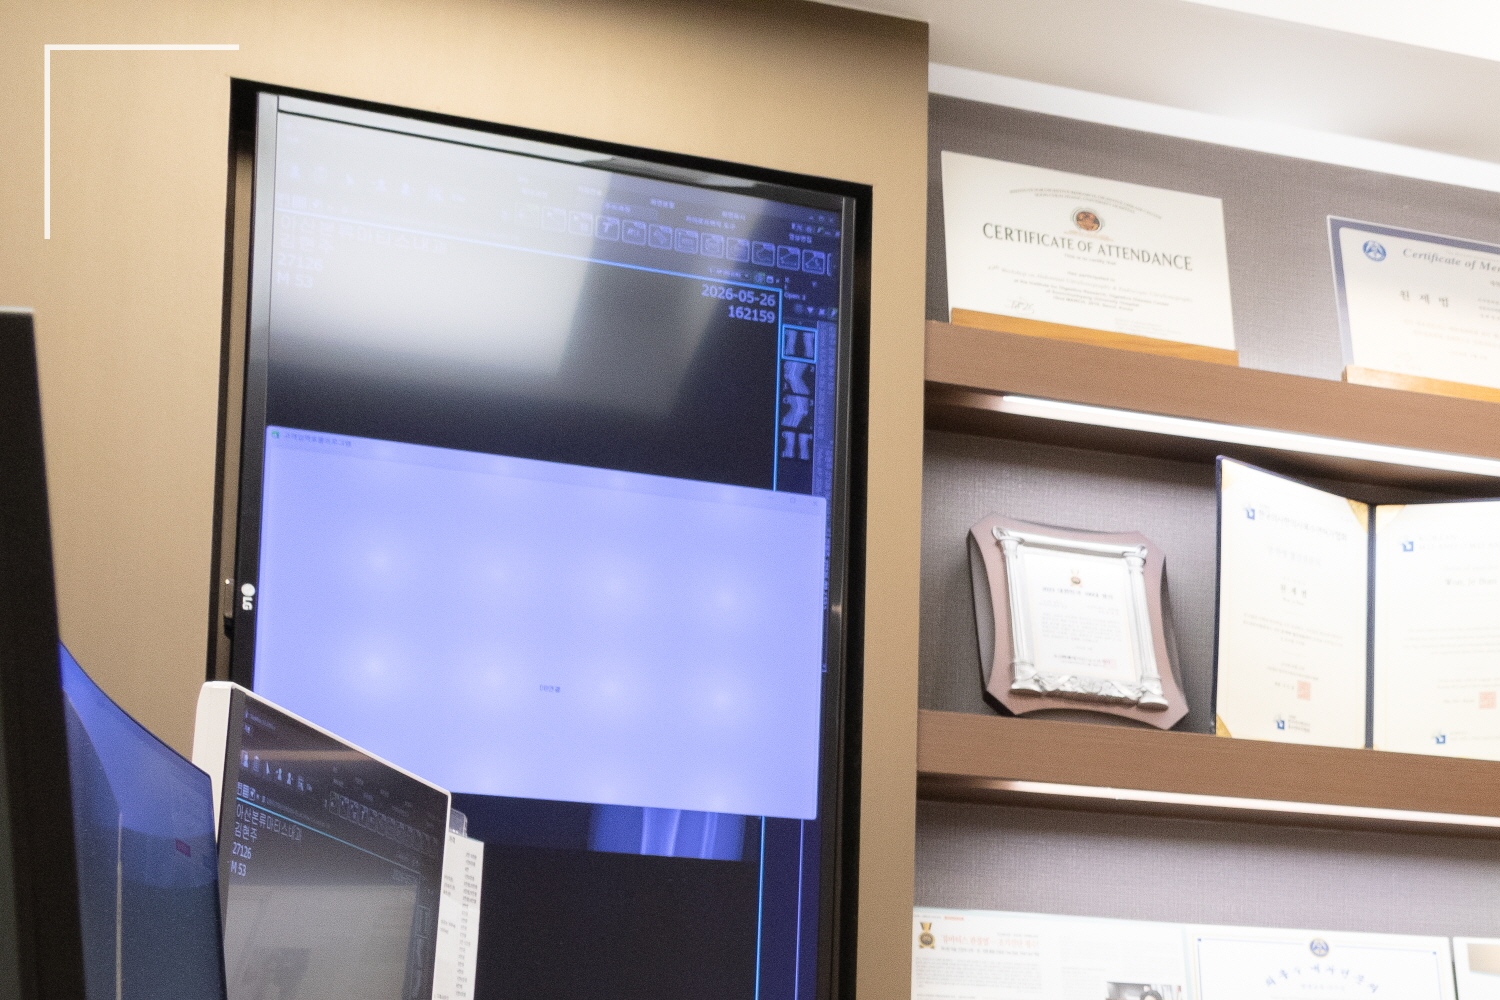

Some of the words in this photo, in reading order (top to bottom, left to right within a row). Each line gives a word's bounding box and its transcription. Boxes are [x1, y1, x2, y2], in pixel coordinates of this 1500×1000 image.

[983, 222, 1074, 251] CERTIFICATE
[1077, 240, 1093, 253] OF
[1097, 244, 1193, 271] ATTENDANCE
[1403, 248, 1461, 267] Certificate
[1465, 256, 1477, 271] of
[702, 284, 776, 307] 2026-05-26
[728, 304, 776, 323] 162159
[242, 597, 253, 611] LG
[232, 841, 252, 860] 27126
[238, 863, 247, 877] 53
